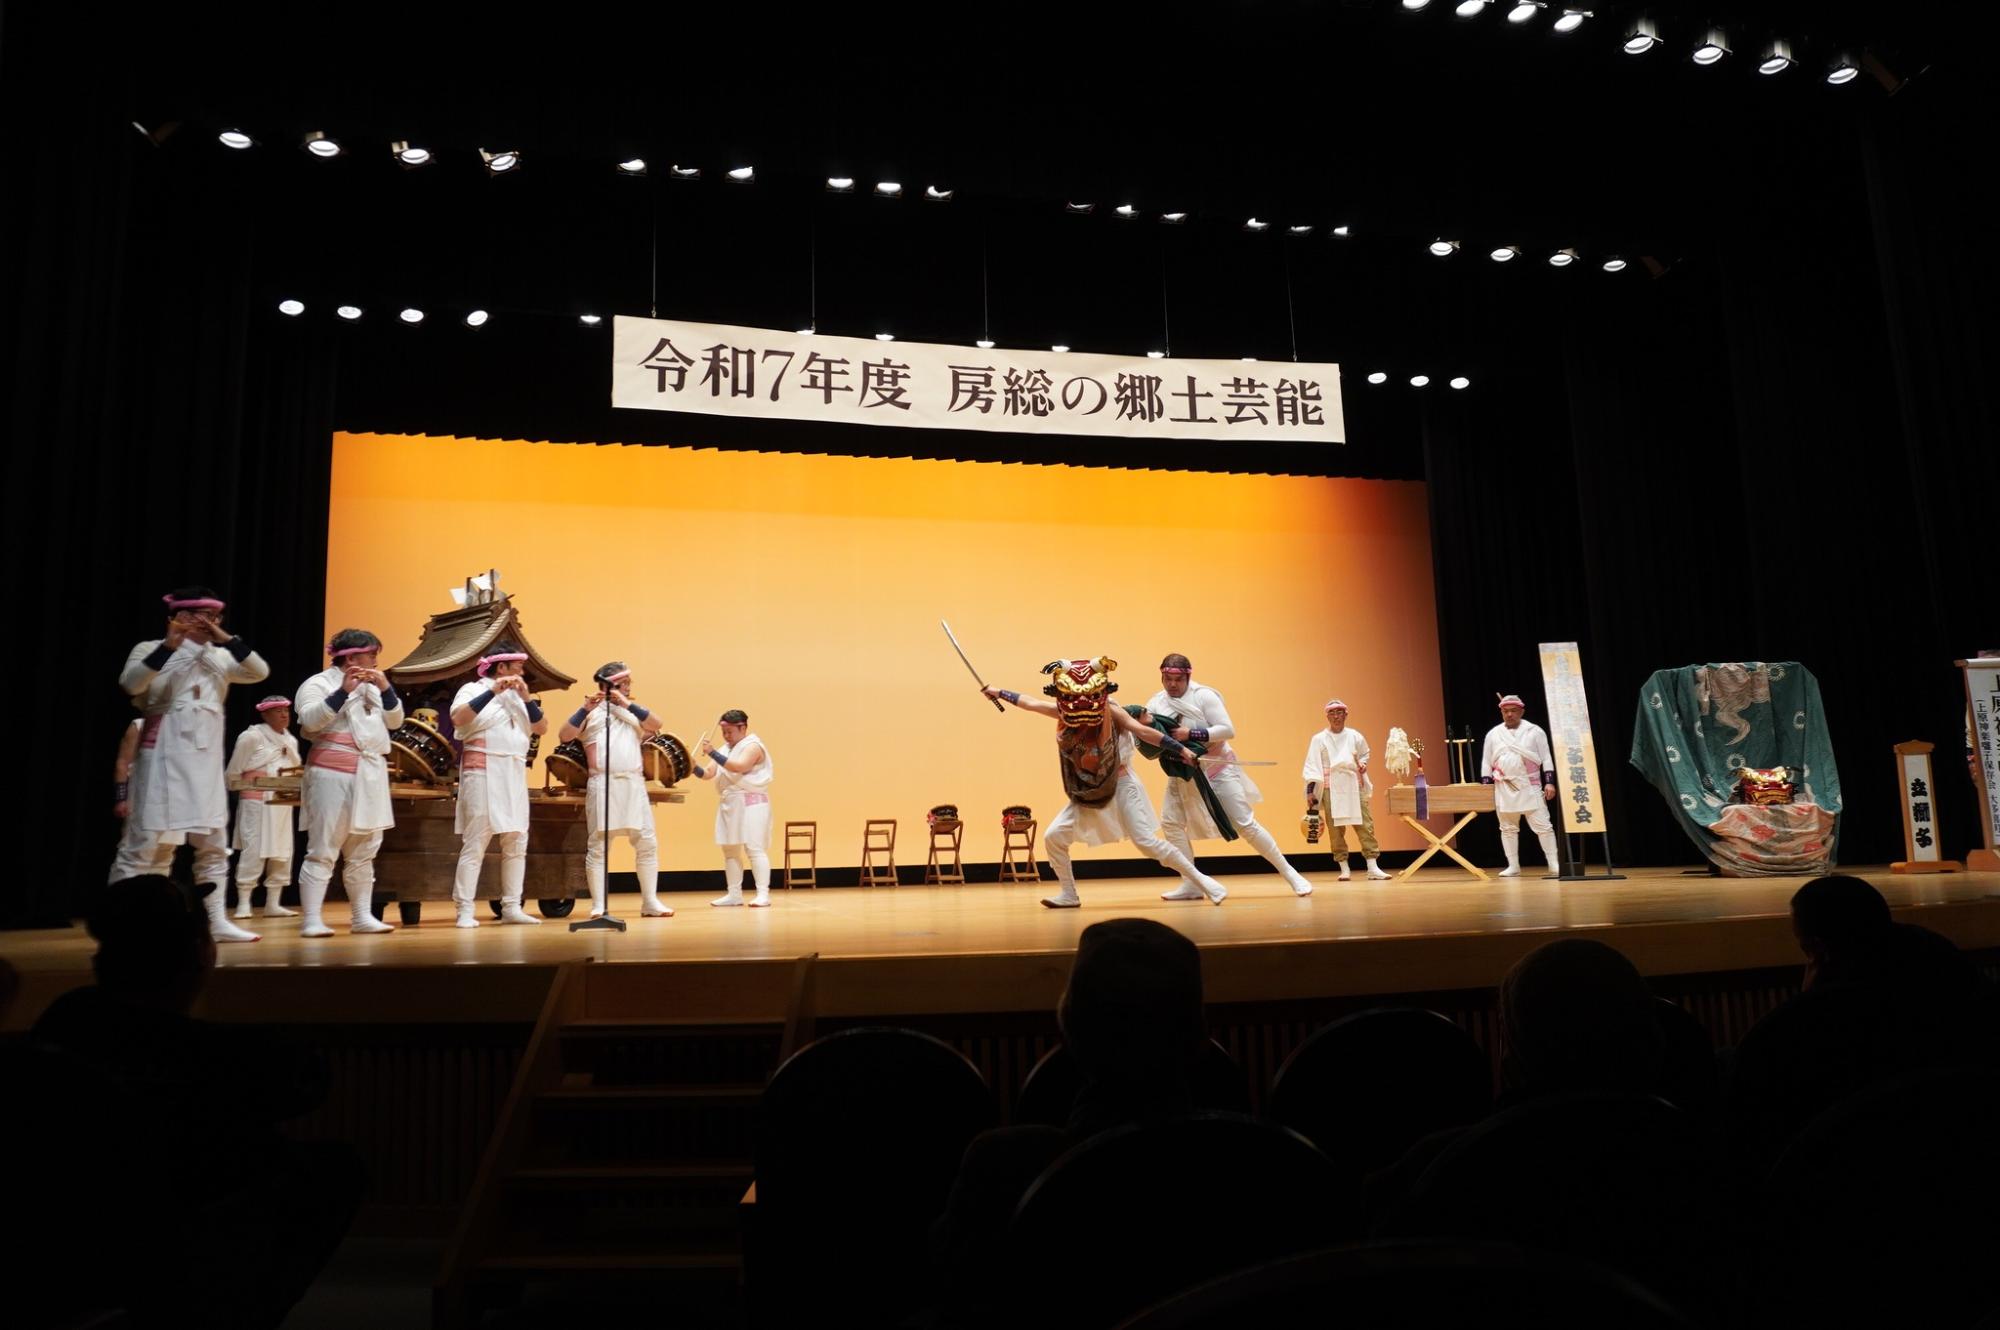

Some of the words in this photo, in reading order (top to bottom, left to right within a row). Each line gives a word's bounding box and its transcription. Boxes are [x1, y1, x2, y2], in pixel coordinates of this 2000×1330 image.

[638, 337, 912, 411] 令和7年度
[947, 364, 1325, 426] 房総の郷土芸能
